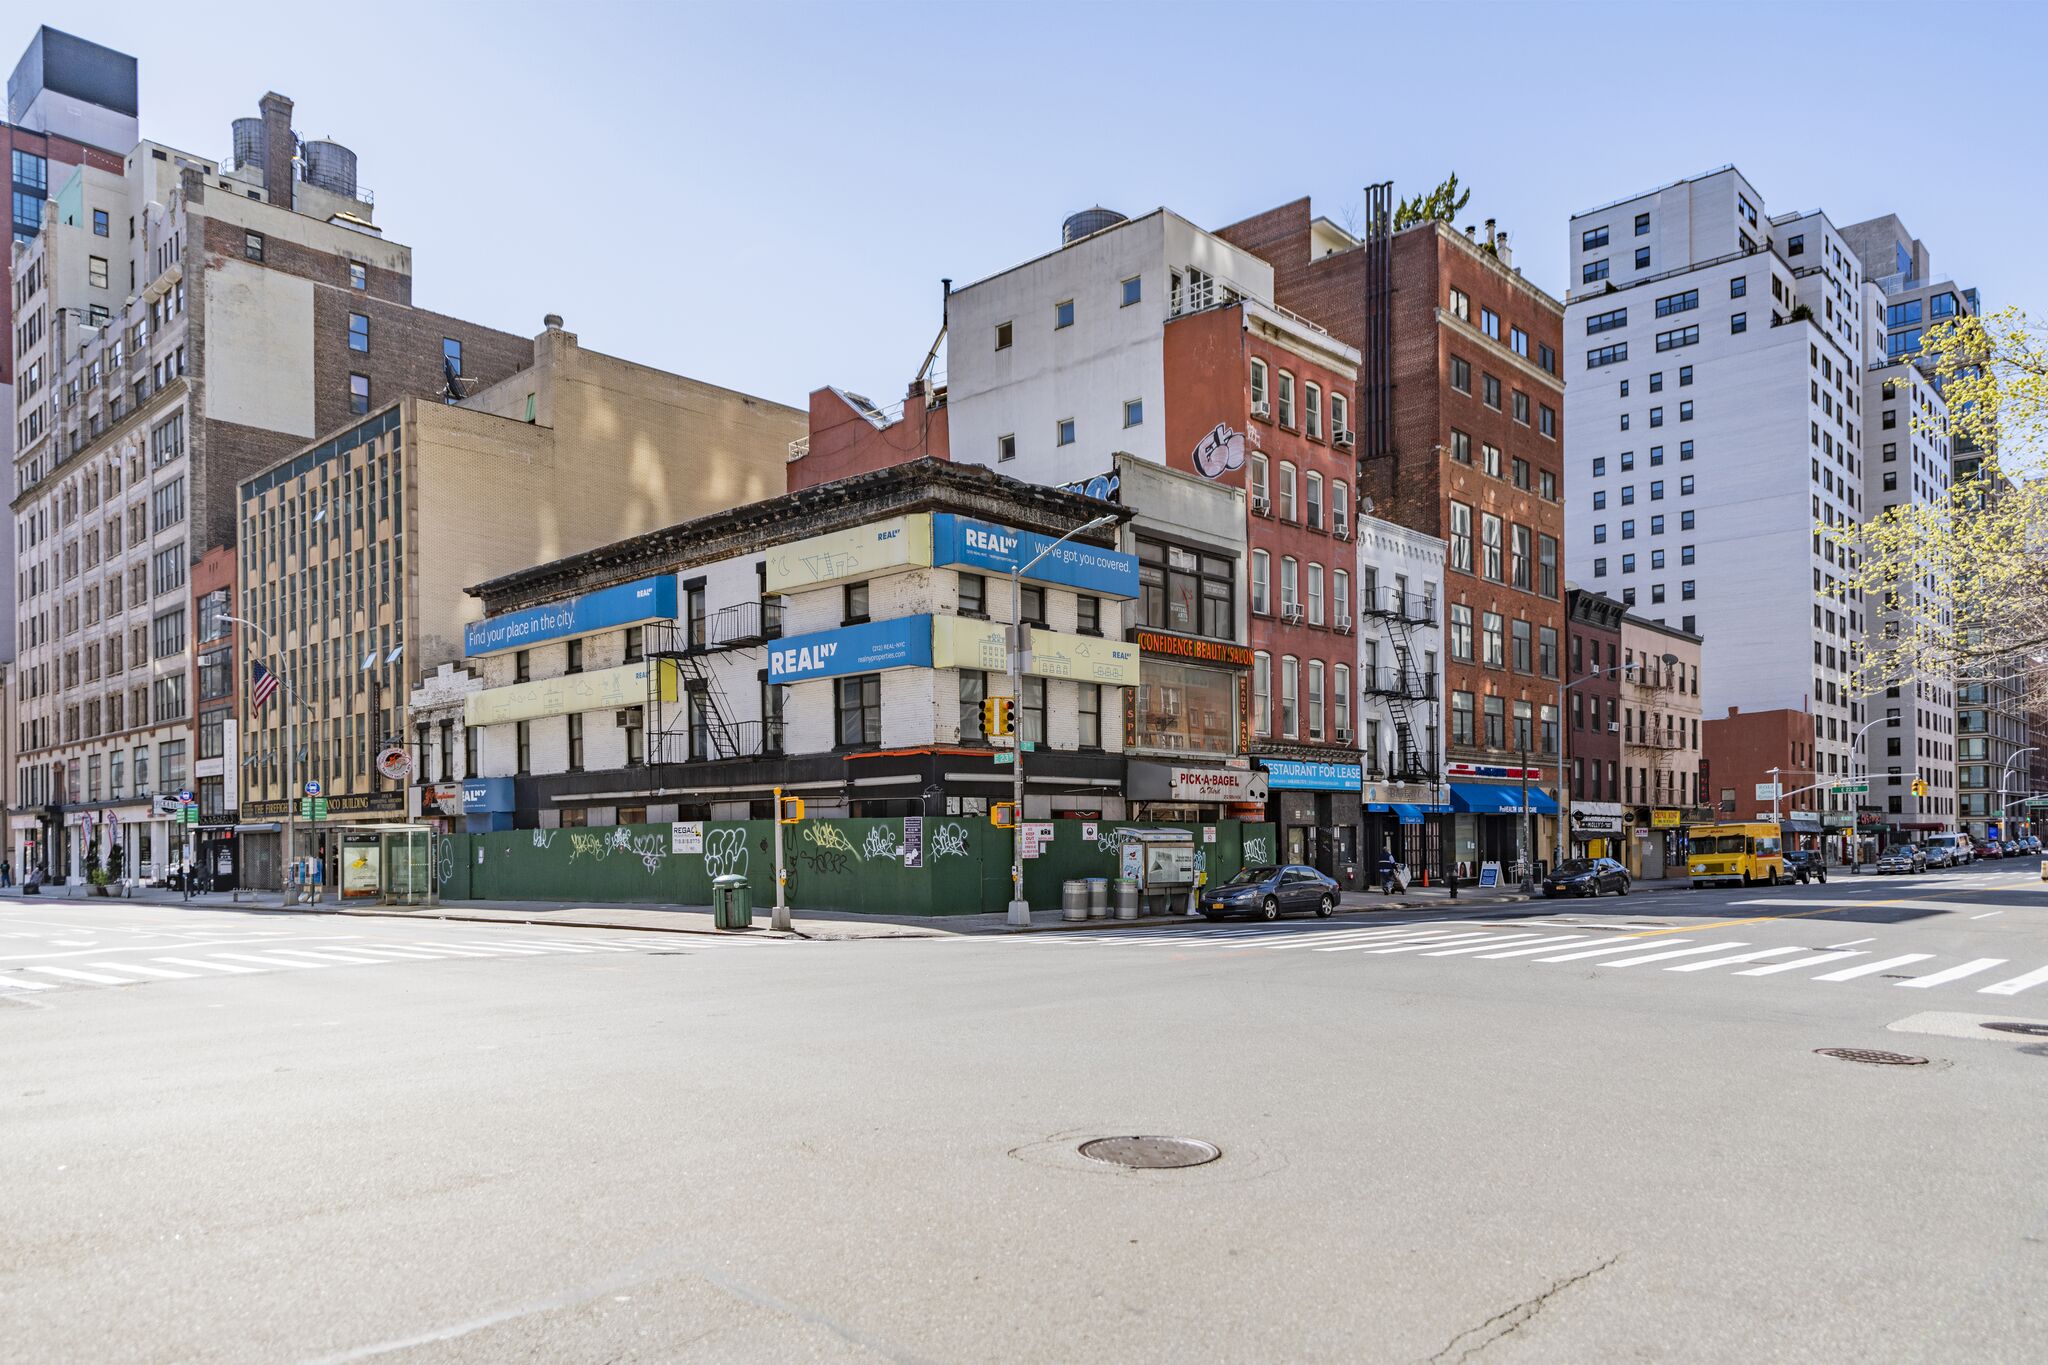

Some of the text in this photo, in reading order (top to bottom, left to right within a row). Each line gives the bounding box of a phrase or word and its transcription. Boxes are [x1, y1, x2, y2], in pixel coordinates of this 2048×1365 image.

[1063, 550, 1078, 564] got
[1079, 552, 1095, 566] you
[1096, 557, 1131, 573] covered.
[469, 609, 575, 647] Find your place in the city.
[857, 651, 906, 663] realnyproperties.com
[1139, 632, 1255, 666] CONFIDENCE BEAUTY SALON
[1264, 763, 1361, 779] ESTAURANT FOR LEASE
[255, 805, 265, 814] THE
[265, 802, 297, 814] FIREFIGHR
